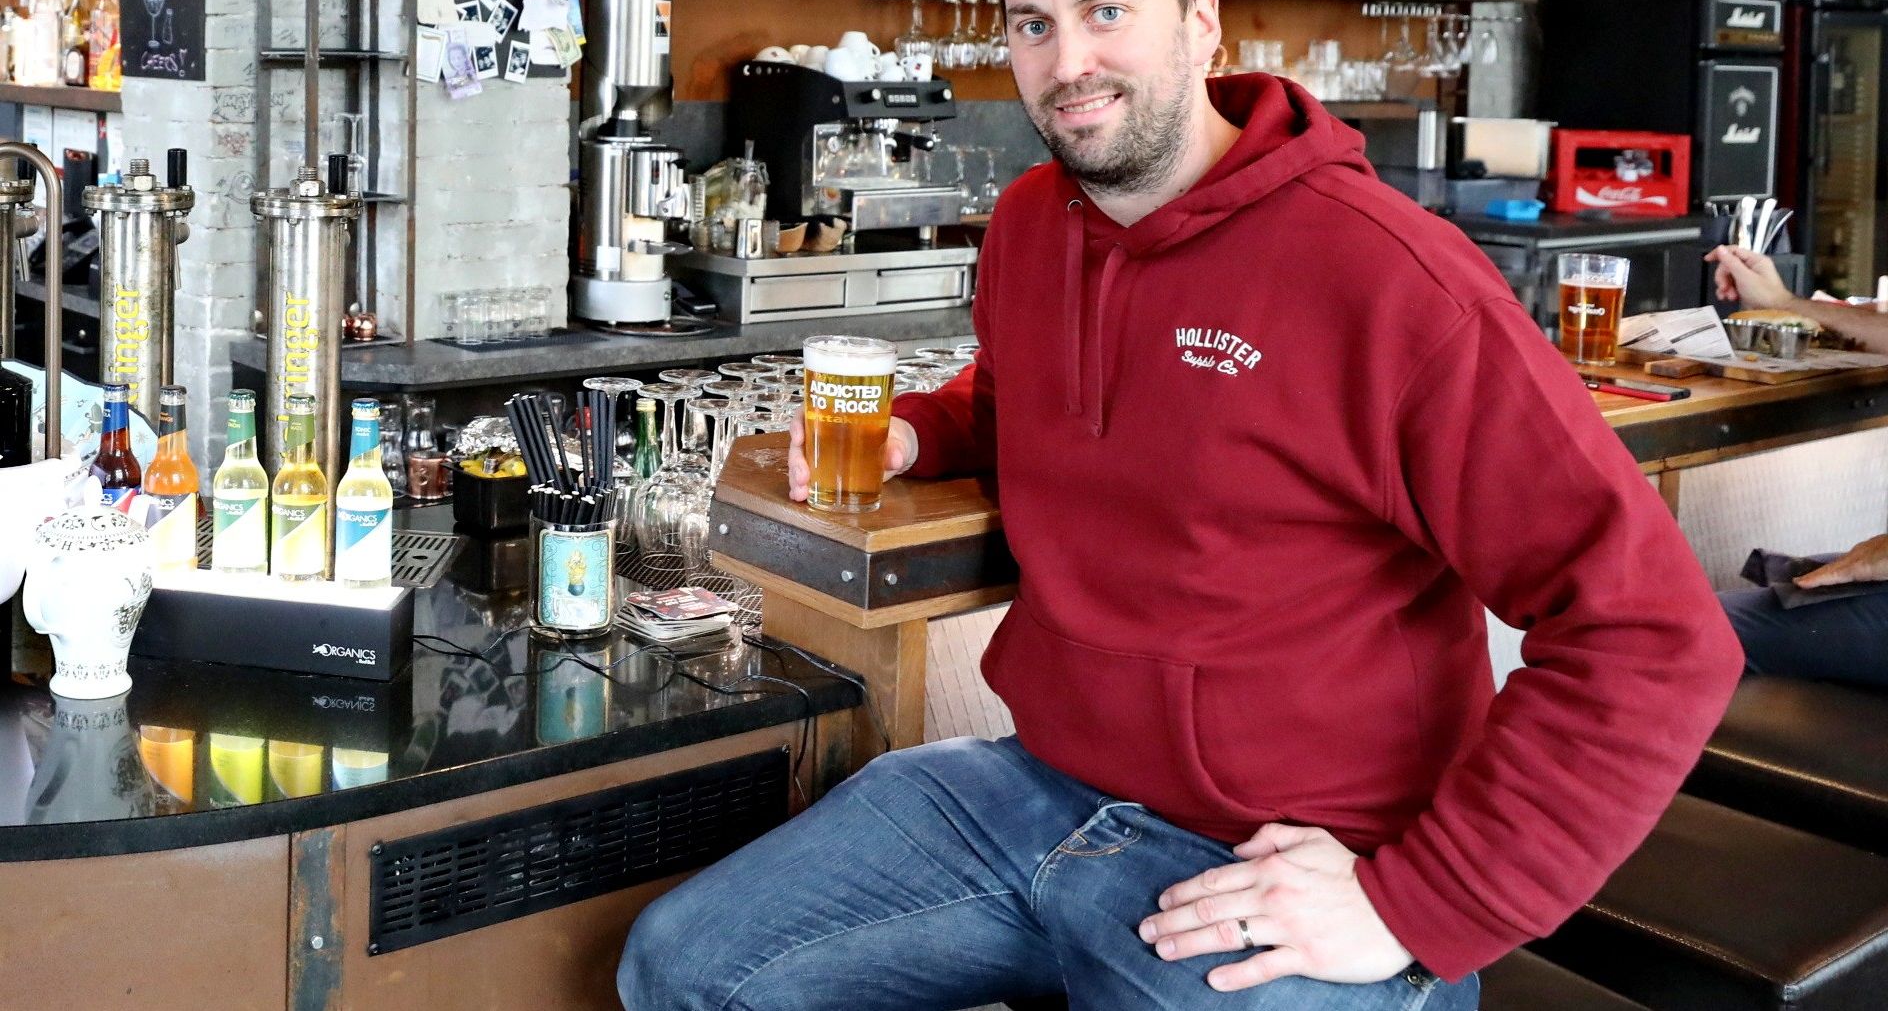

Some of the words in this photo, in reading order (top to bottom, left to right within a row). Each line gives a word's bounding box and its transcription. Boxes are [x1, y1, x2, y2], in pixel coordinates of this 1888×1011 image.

[1175, 327, 1262, 370] HOLLISTER
[1181, 350, 1216, 370] Supply
[810, 379, 882, 399] ADDICTED
[810, 394, 827, 410] TO
[834, 399, 879, 413] ROCK
[320, 643, 376, 660] ORGANICS
